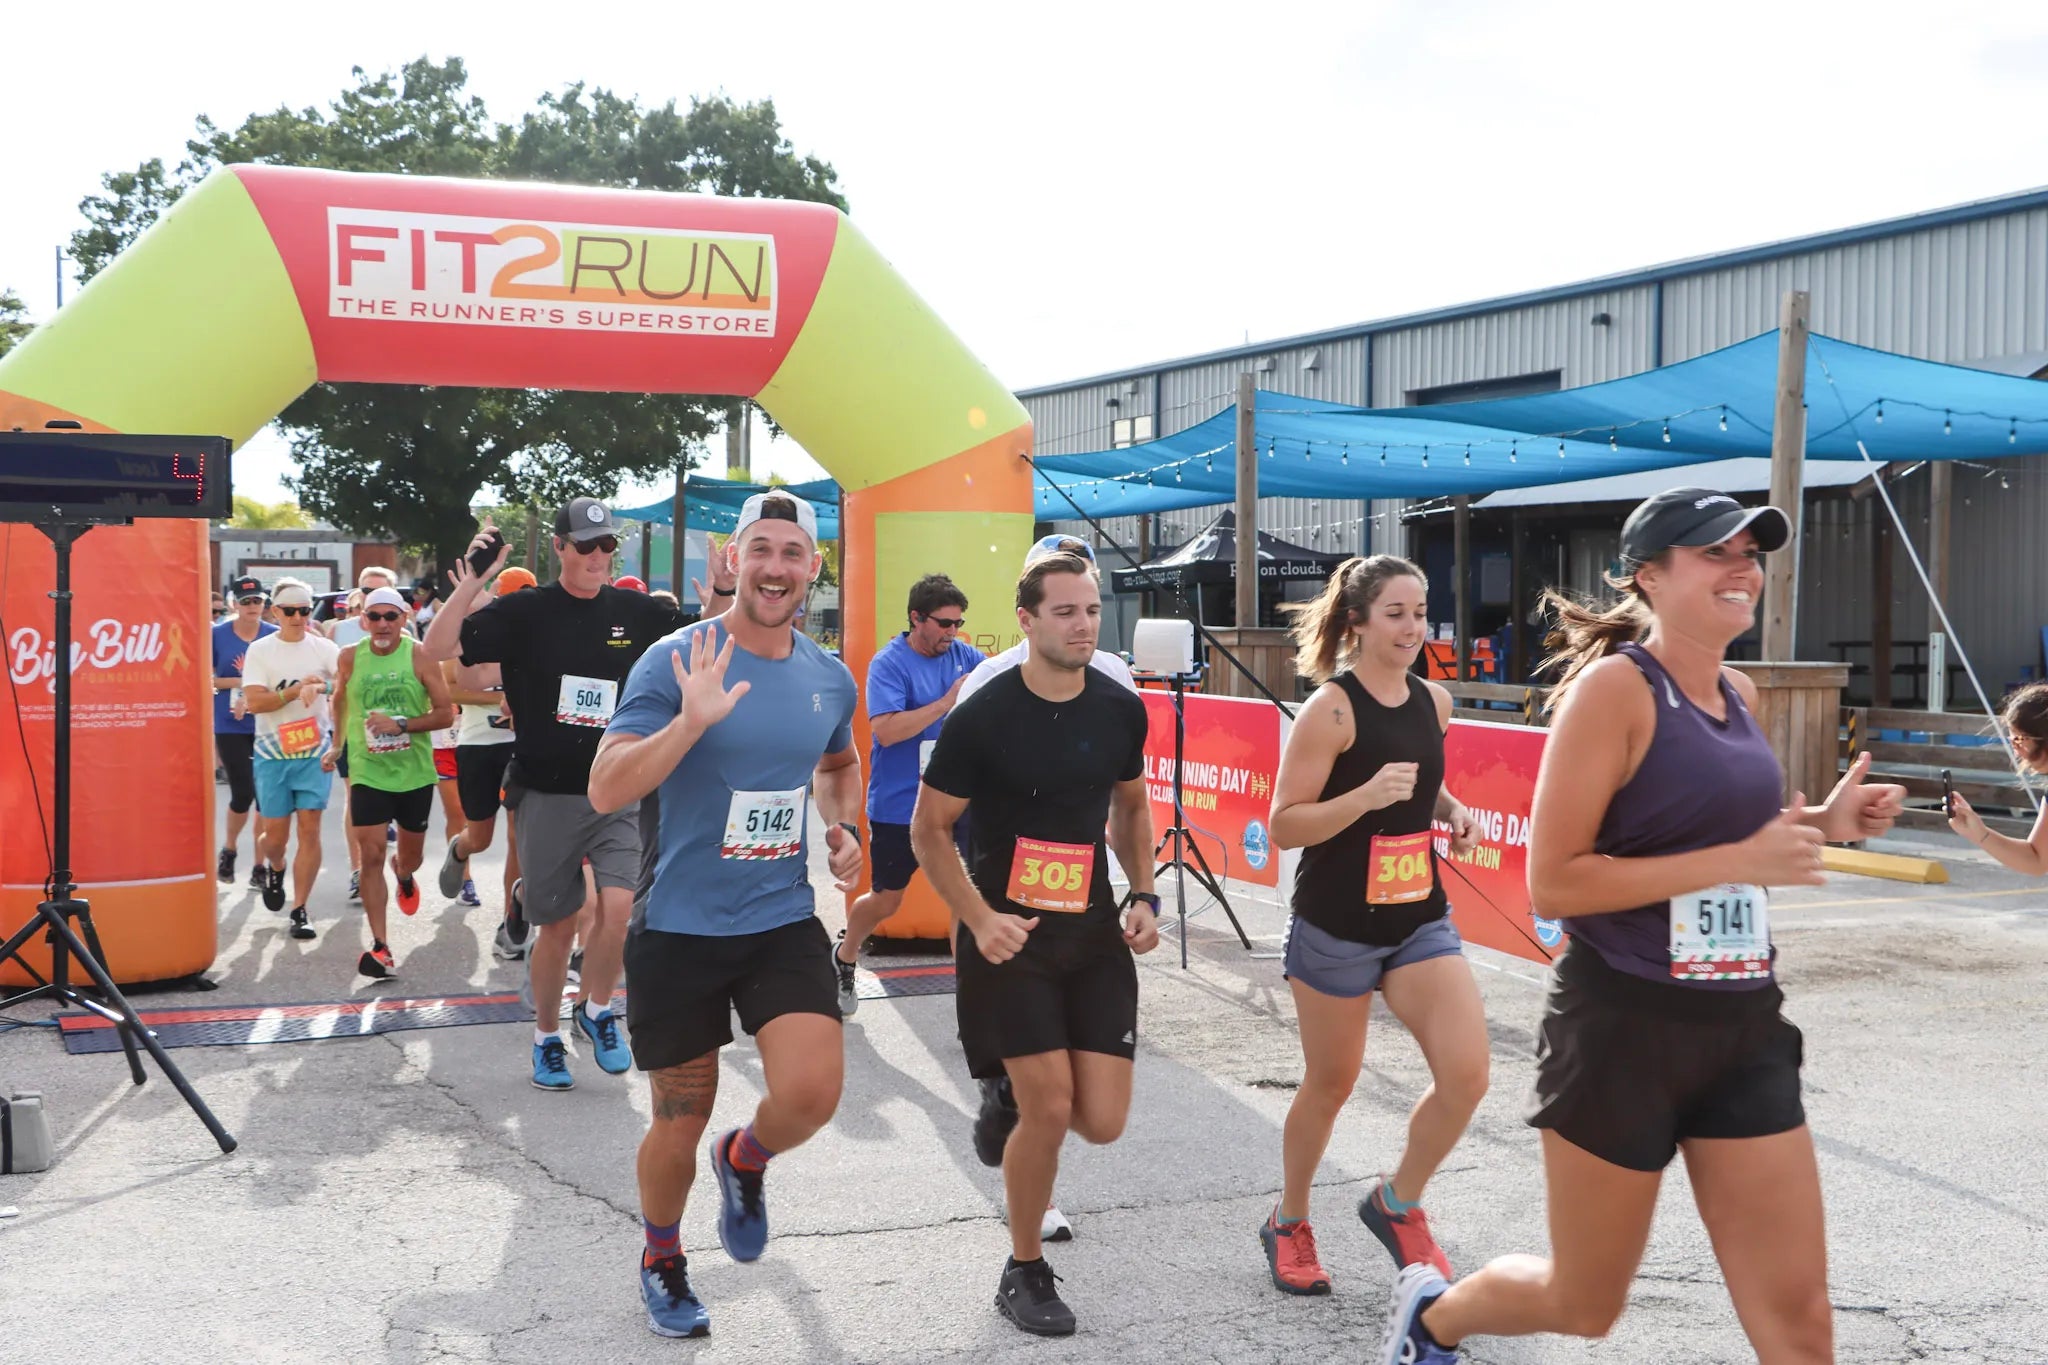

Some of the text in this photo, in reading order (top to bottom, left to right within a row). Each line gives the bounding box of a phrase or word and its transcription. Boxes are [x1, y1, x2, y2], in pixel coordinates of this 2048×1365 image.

[336, 223, 766, 305] FIT2RUN
[337, 297, 769, 334] THE RUNNER'S SUPERSTORE
[173, 452, 205, 501] 4
[1260, 560, 1326, 577] on clouds.
[89, 618, 164, 669] Bill
[576, 689, 602, 708] 504
[286, 727, 315, 745] 314
[1157, 757, 1218, 789] RUNING
[1220, 766, 1250, 794] DAY
[1151, 784, 1174, 804] CLUB
[1182, 789, 1196, 807] UN
[1196, 792, 1217, 811] RUN
[746, 808, 794, 832] 5142
[1505, 813, 1531, 848] DA
[1019, 857, 1086, 891] 305
[1376, 851, 1428, 883] 304
[1475, 845, 1501, 871] RUN
[1698, 899, 1753, 935] 5141
